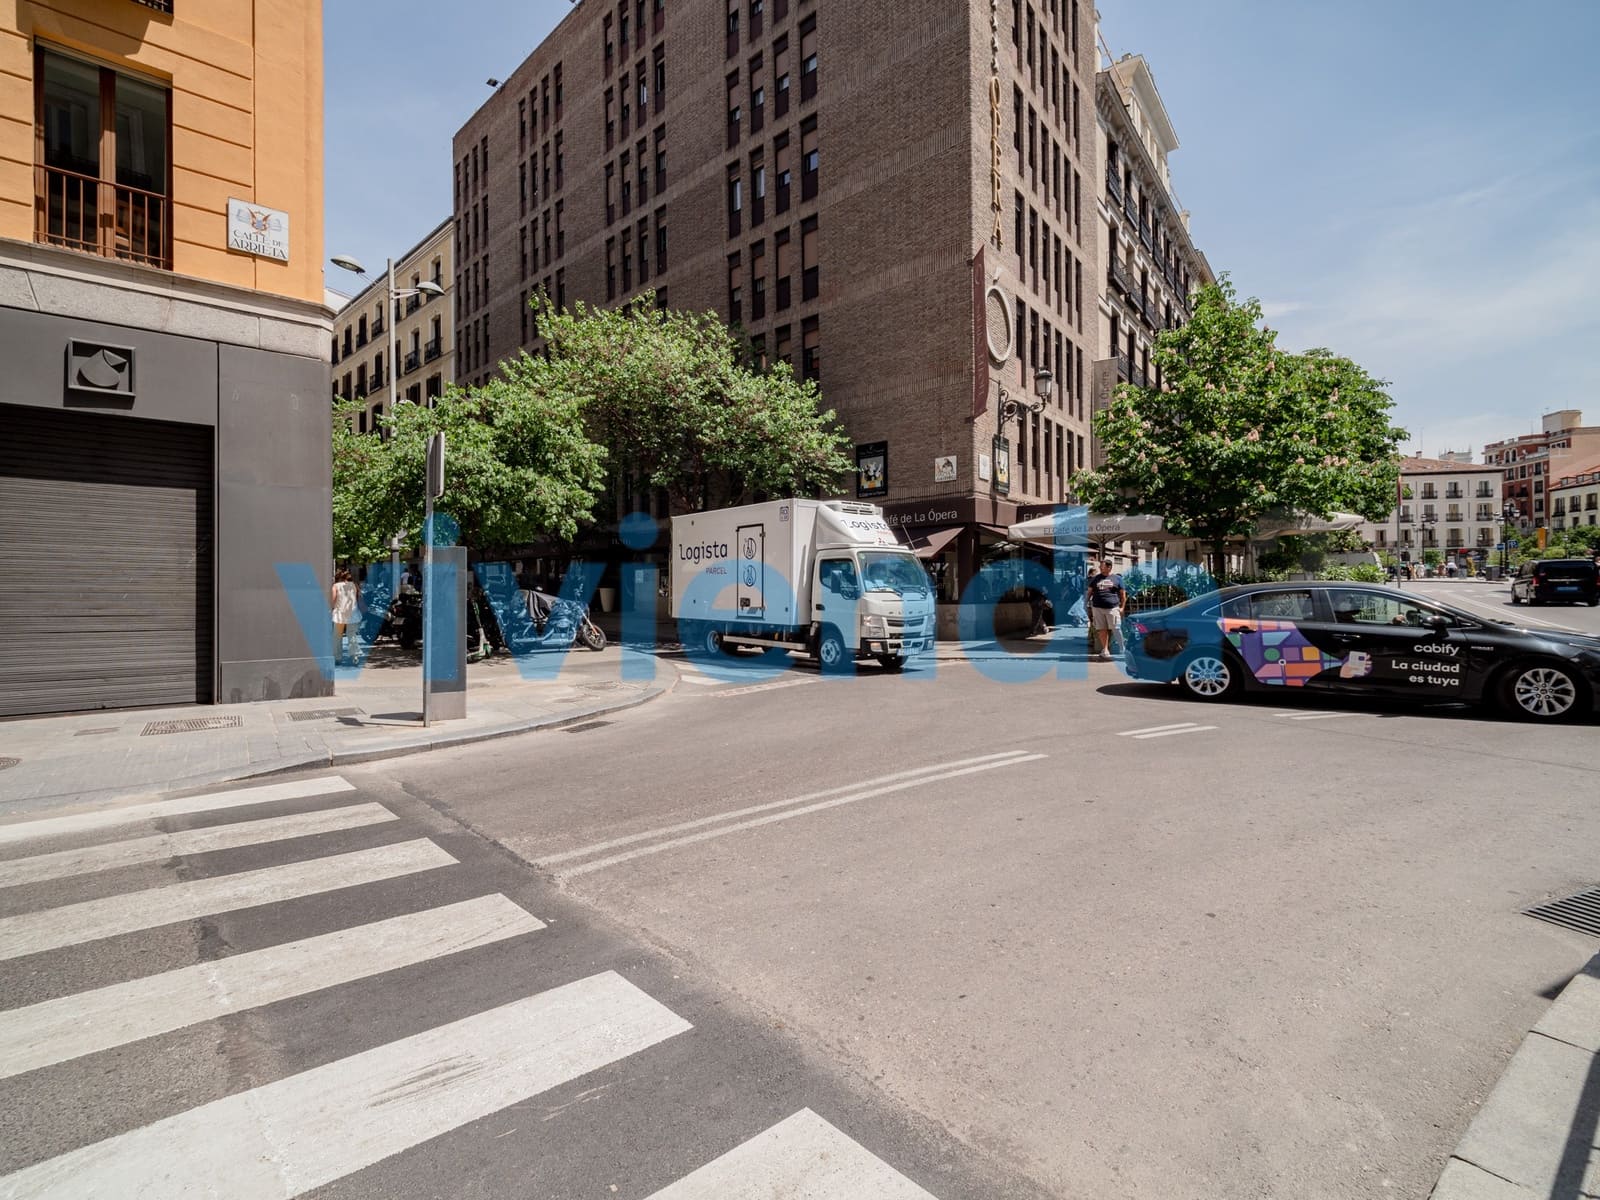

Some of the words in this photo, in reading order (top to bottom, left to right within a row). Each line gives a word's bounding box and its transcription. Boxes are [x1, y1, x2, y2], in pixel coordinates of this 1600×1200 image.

[233, 229, 266, 244] CALLE
[272, 239, 281, 247] DE
[231, 238, 287, 259] ARRIETA
[901, 513, 912, 523] de
[914, 511, 926, 522] La
[928, 508, 958, 522] Ópera
[1083, 524, 1094, 533] La
[705, 567, 727, 575] PARCEL
[1413, 643, 1460, 656] cabify
[1391, 660, 1408, 669] La
[1411, 661, 1460, 673] ciudad
[1408, 675, 1424, 683] es
[1427, 674, 1459, 687] tuya
